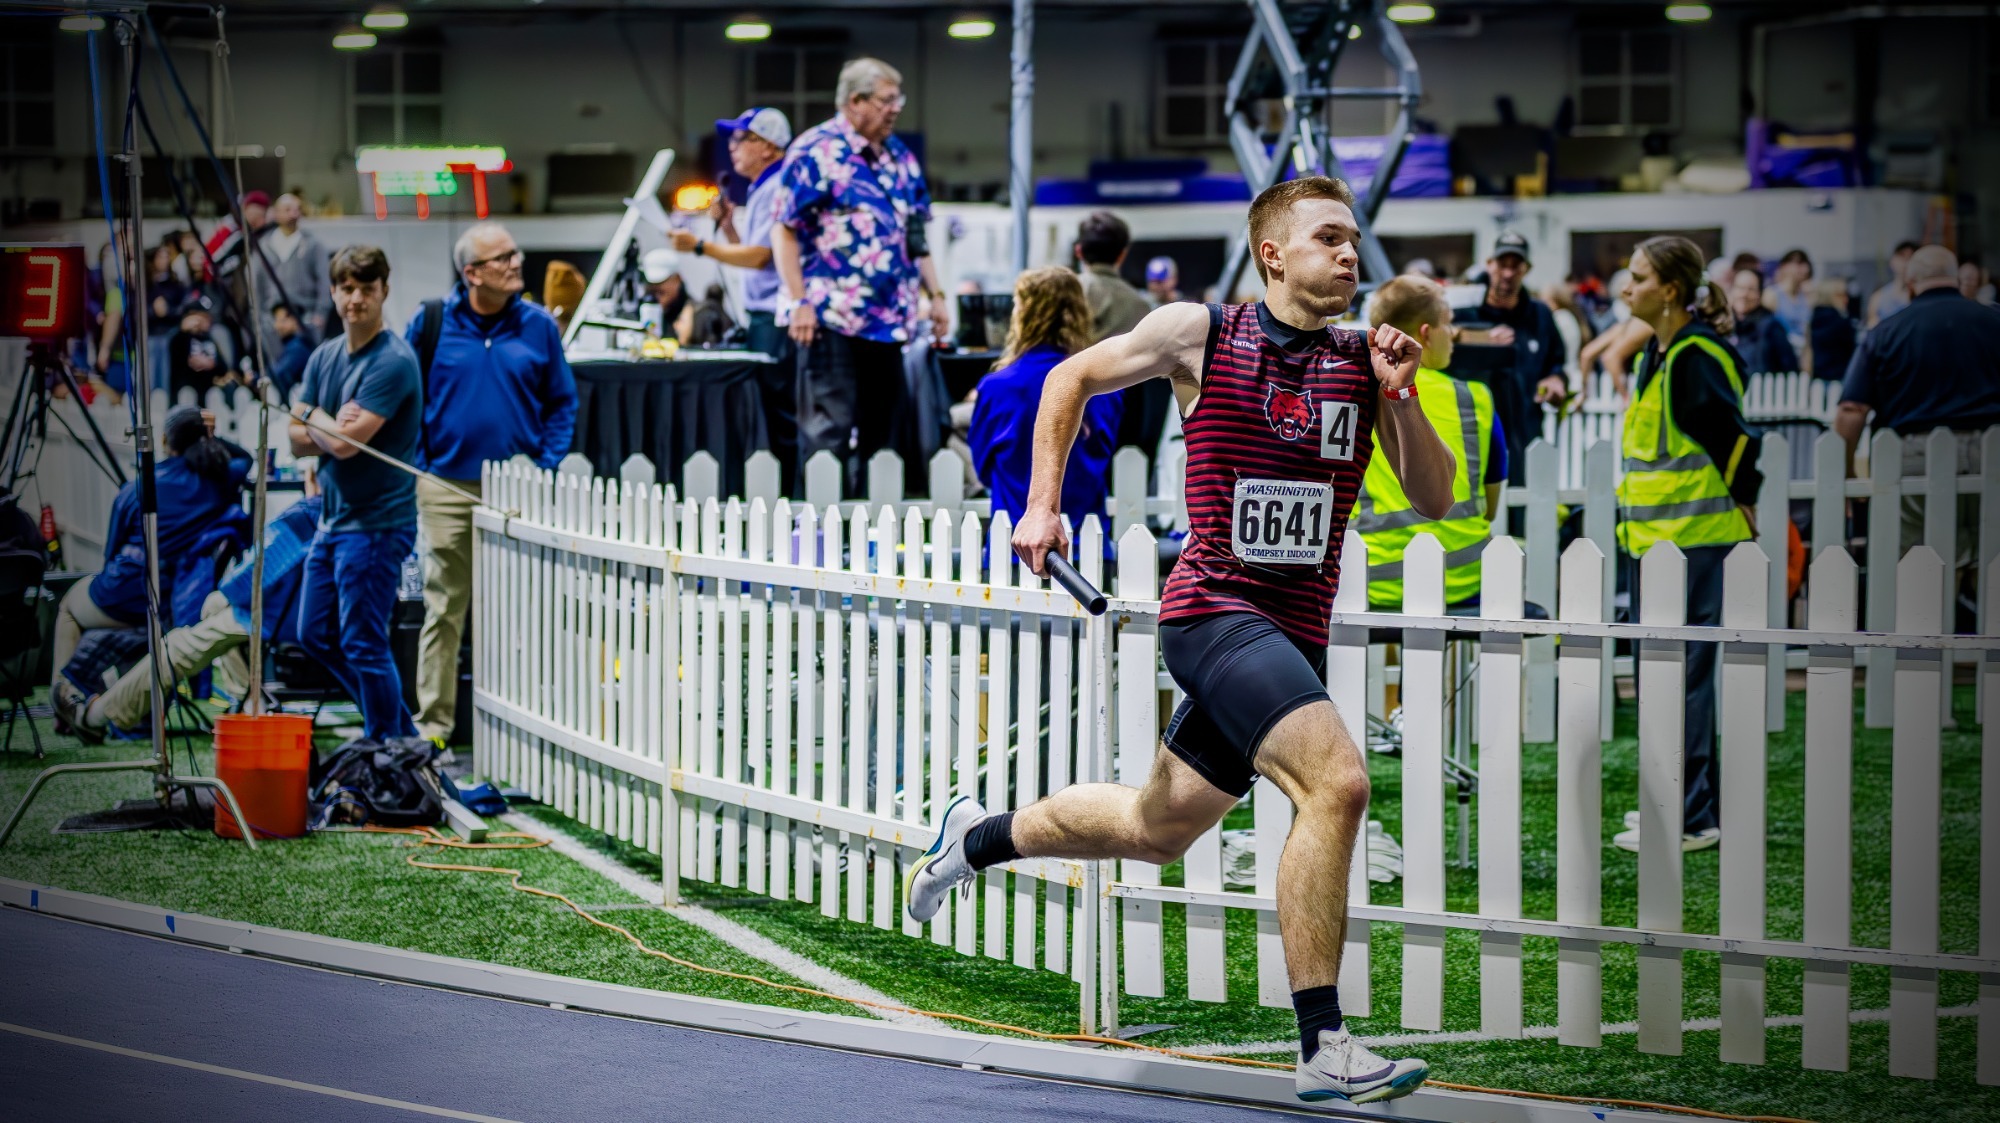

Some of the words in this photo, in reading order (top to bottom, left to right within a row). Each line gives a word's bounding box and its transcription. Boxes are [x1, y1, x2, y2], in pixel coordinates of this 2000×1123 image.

[23, 255, 61, 327] 3
[1231, 339, 1258, 350] CENTRAL
[1327, 405, 1351, 457] 4
[1246, 484, 1325, 497] WASHINGTON
[1239, 498, 1323, 546] 6641
[1245, 547, 1285, 558] DEMPSEY
[1287, 550, 1316, 559] INDOOR
